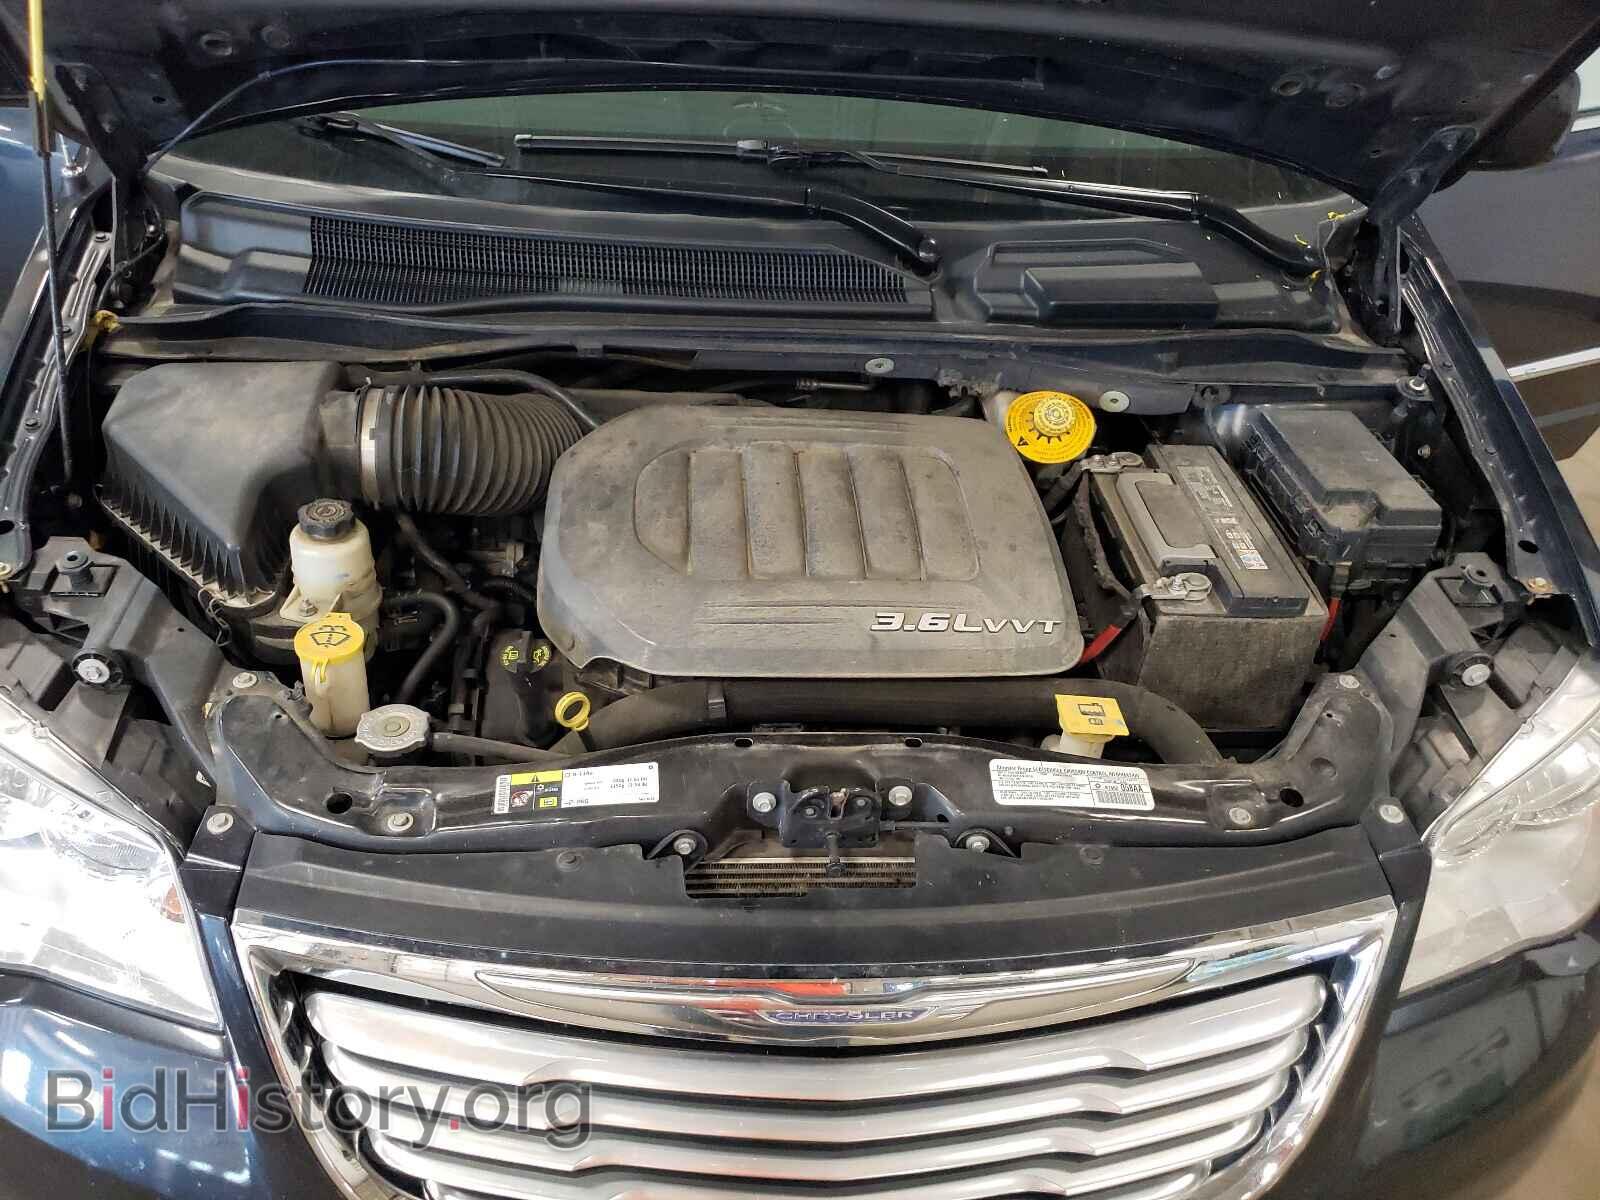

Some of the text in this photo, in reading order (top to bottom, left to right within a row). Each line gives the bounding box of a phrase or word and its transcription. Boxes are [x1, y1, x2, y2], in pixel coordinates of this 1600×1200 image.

[870, 612, 1064, 634] 3.6L VVT
[774, 1009, 914, 1021] CHRYSLER
